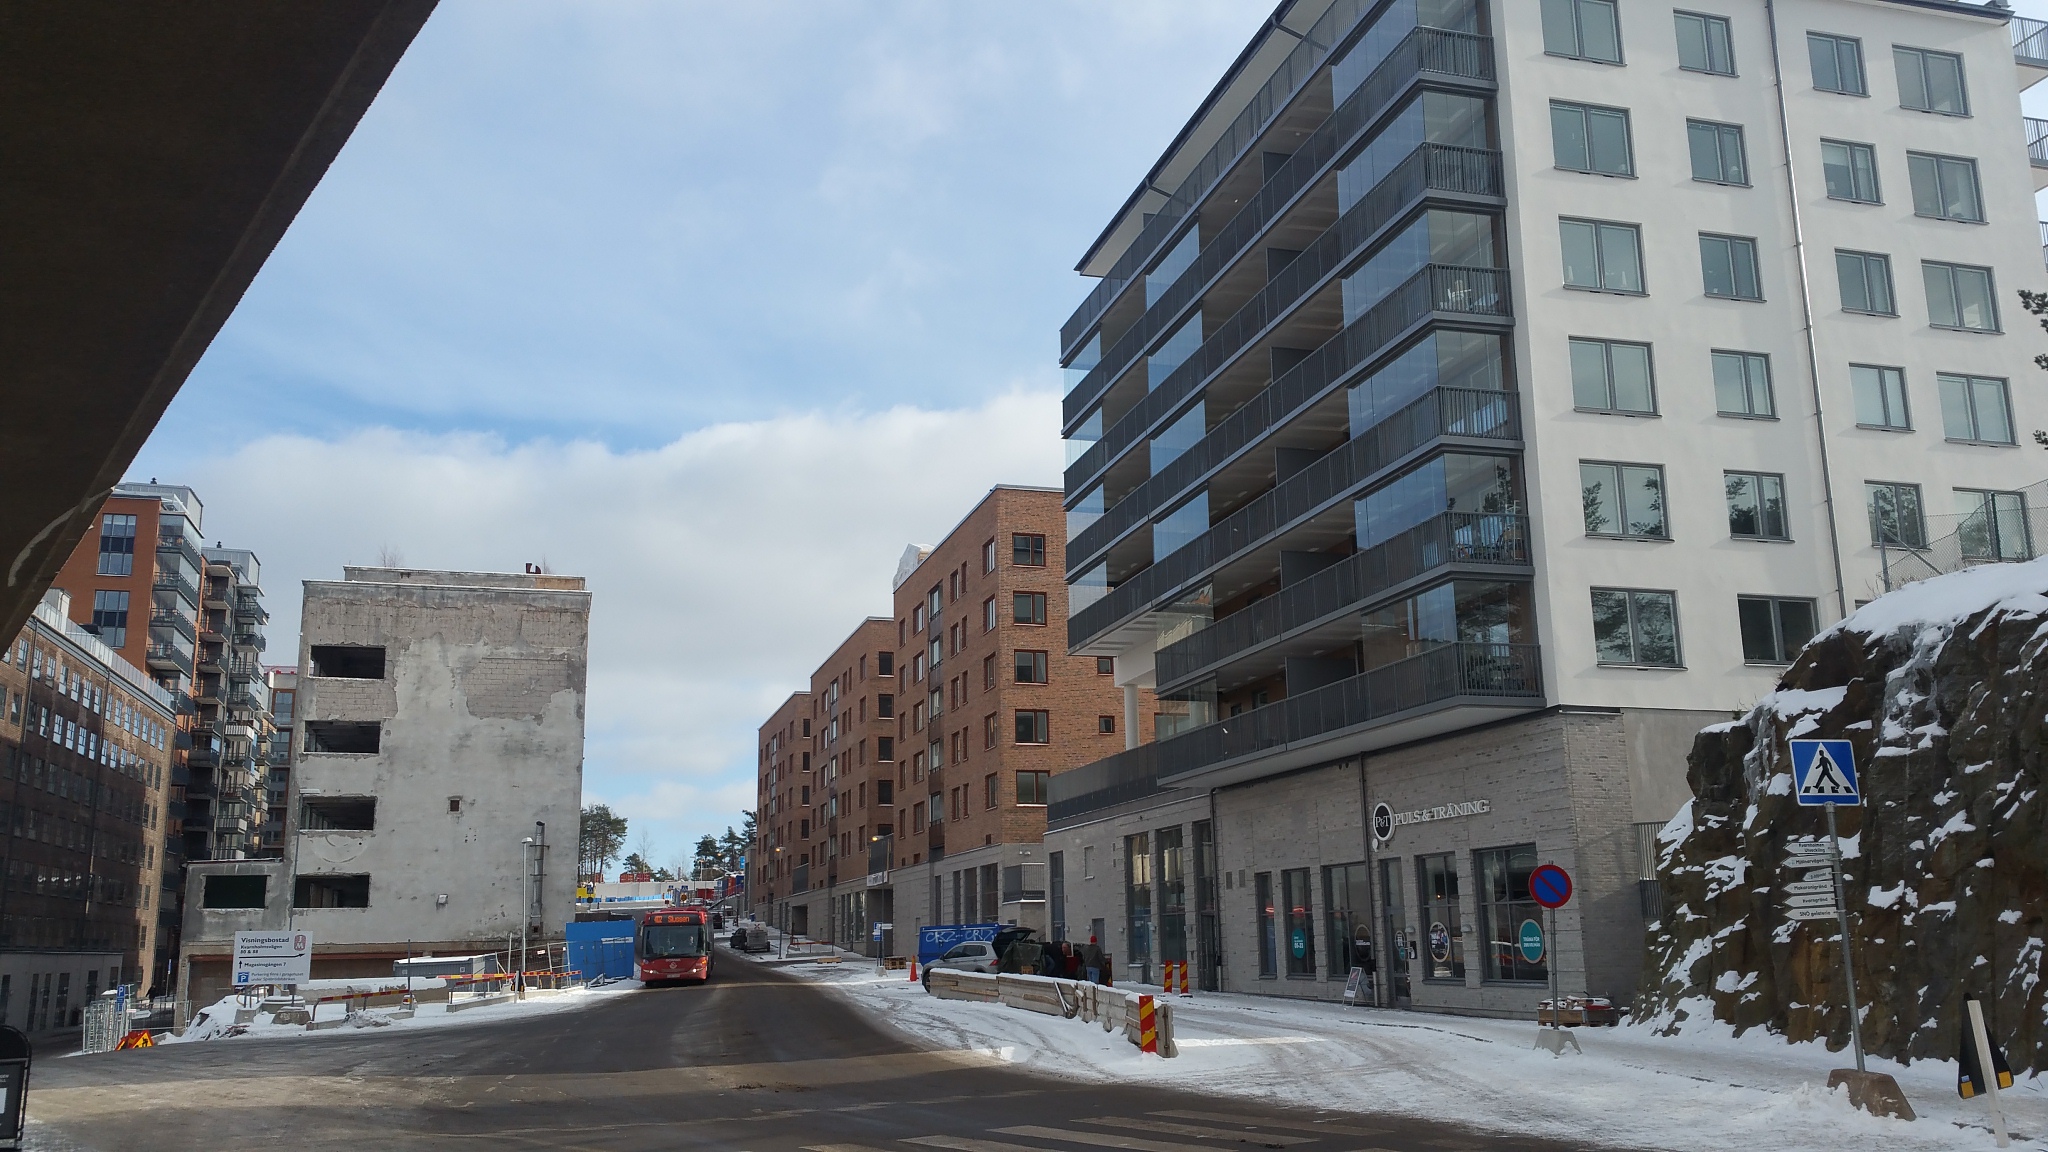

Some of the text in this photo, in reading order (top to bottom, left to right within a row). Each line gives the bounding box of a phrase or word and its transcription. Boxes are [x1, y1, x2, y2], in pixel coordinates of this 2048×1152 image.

[1394, 799, 1491, 826] PULS & TRÄNING
[1375, 815, 1389, 827] P&T
[667, 915, 690, 923] Slussen
